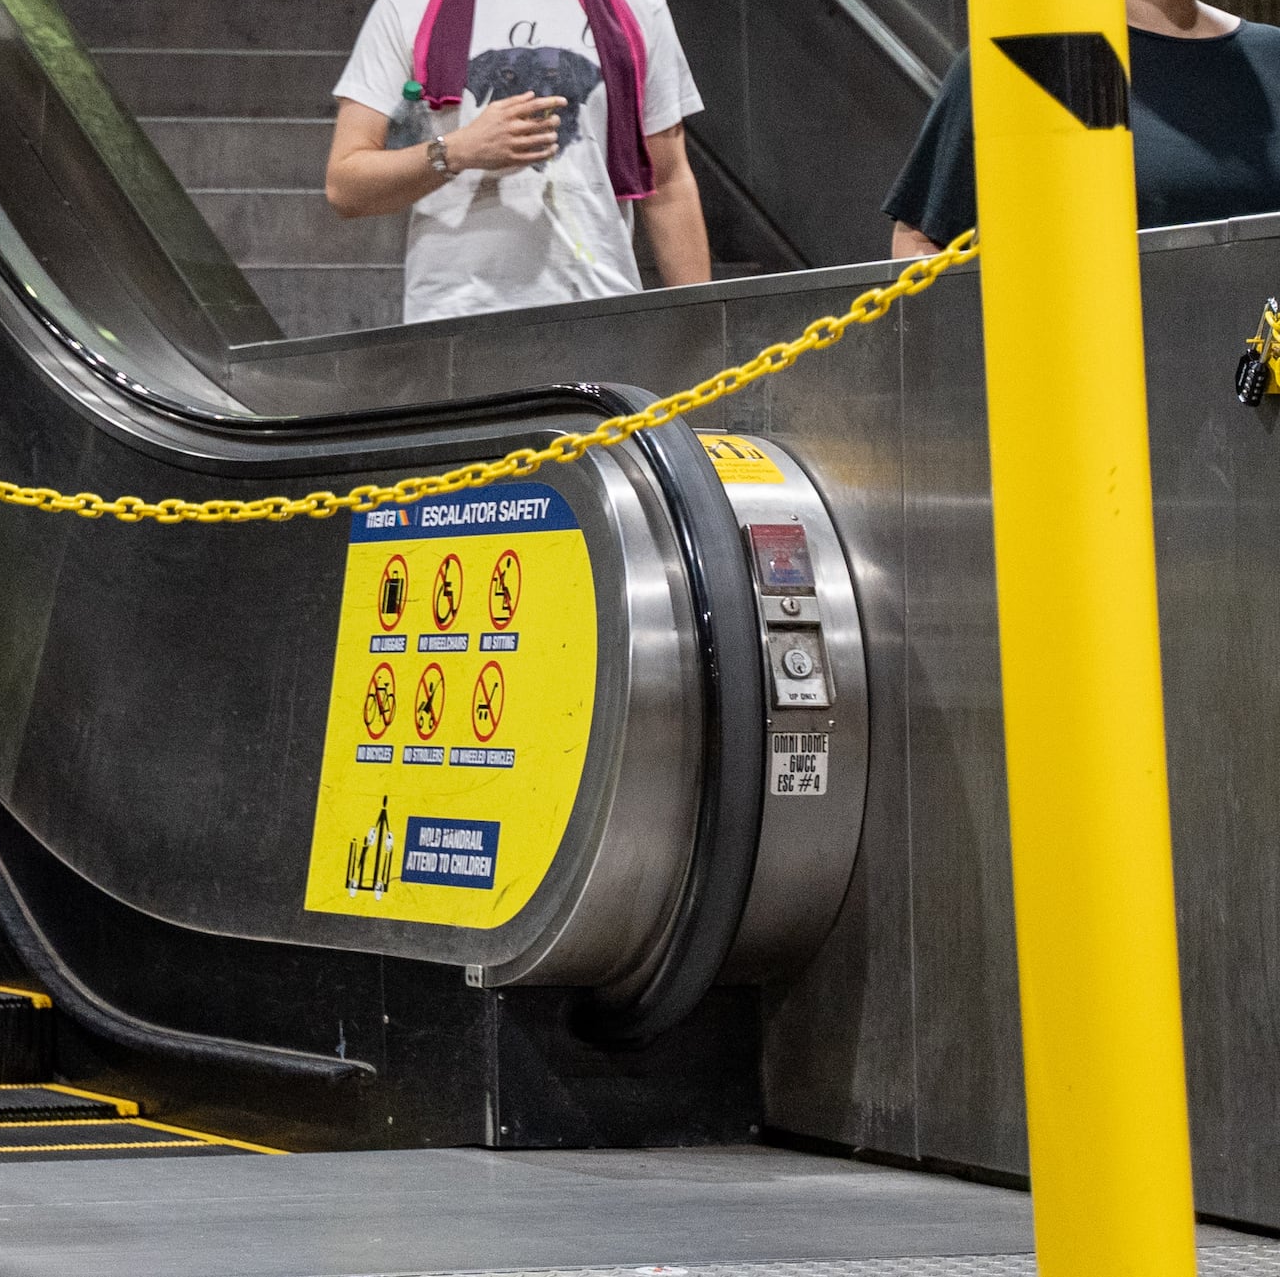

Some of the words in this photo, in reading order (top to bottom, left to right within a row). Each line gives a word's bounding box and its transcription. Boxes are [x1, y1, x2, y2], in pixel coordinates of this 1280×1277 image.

[366, 509, 397, 529] marta
[421, 501, 497, 527] ESCALATOR
[498, 497, 551, 522] SAFETY
[800, 693, 817, 701] ONLY
[774, 735, 798, 753] OMNI
[801, 735, 827, 753] DOME
[790, 755, 816, 773] GWCC
[777, 774, 794, 792] ESC
[419, 827, 441, 848] HOLD
[442, 828, 484, 851] HANDRAIL
[406, 851, 438, 872] ATTEND
[438, 853, 450, 873] TO
[450, 854, 492, 877] CHILDREN
